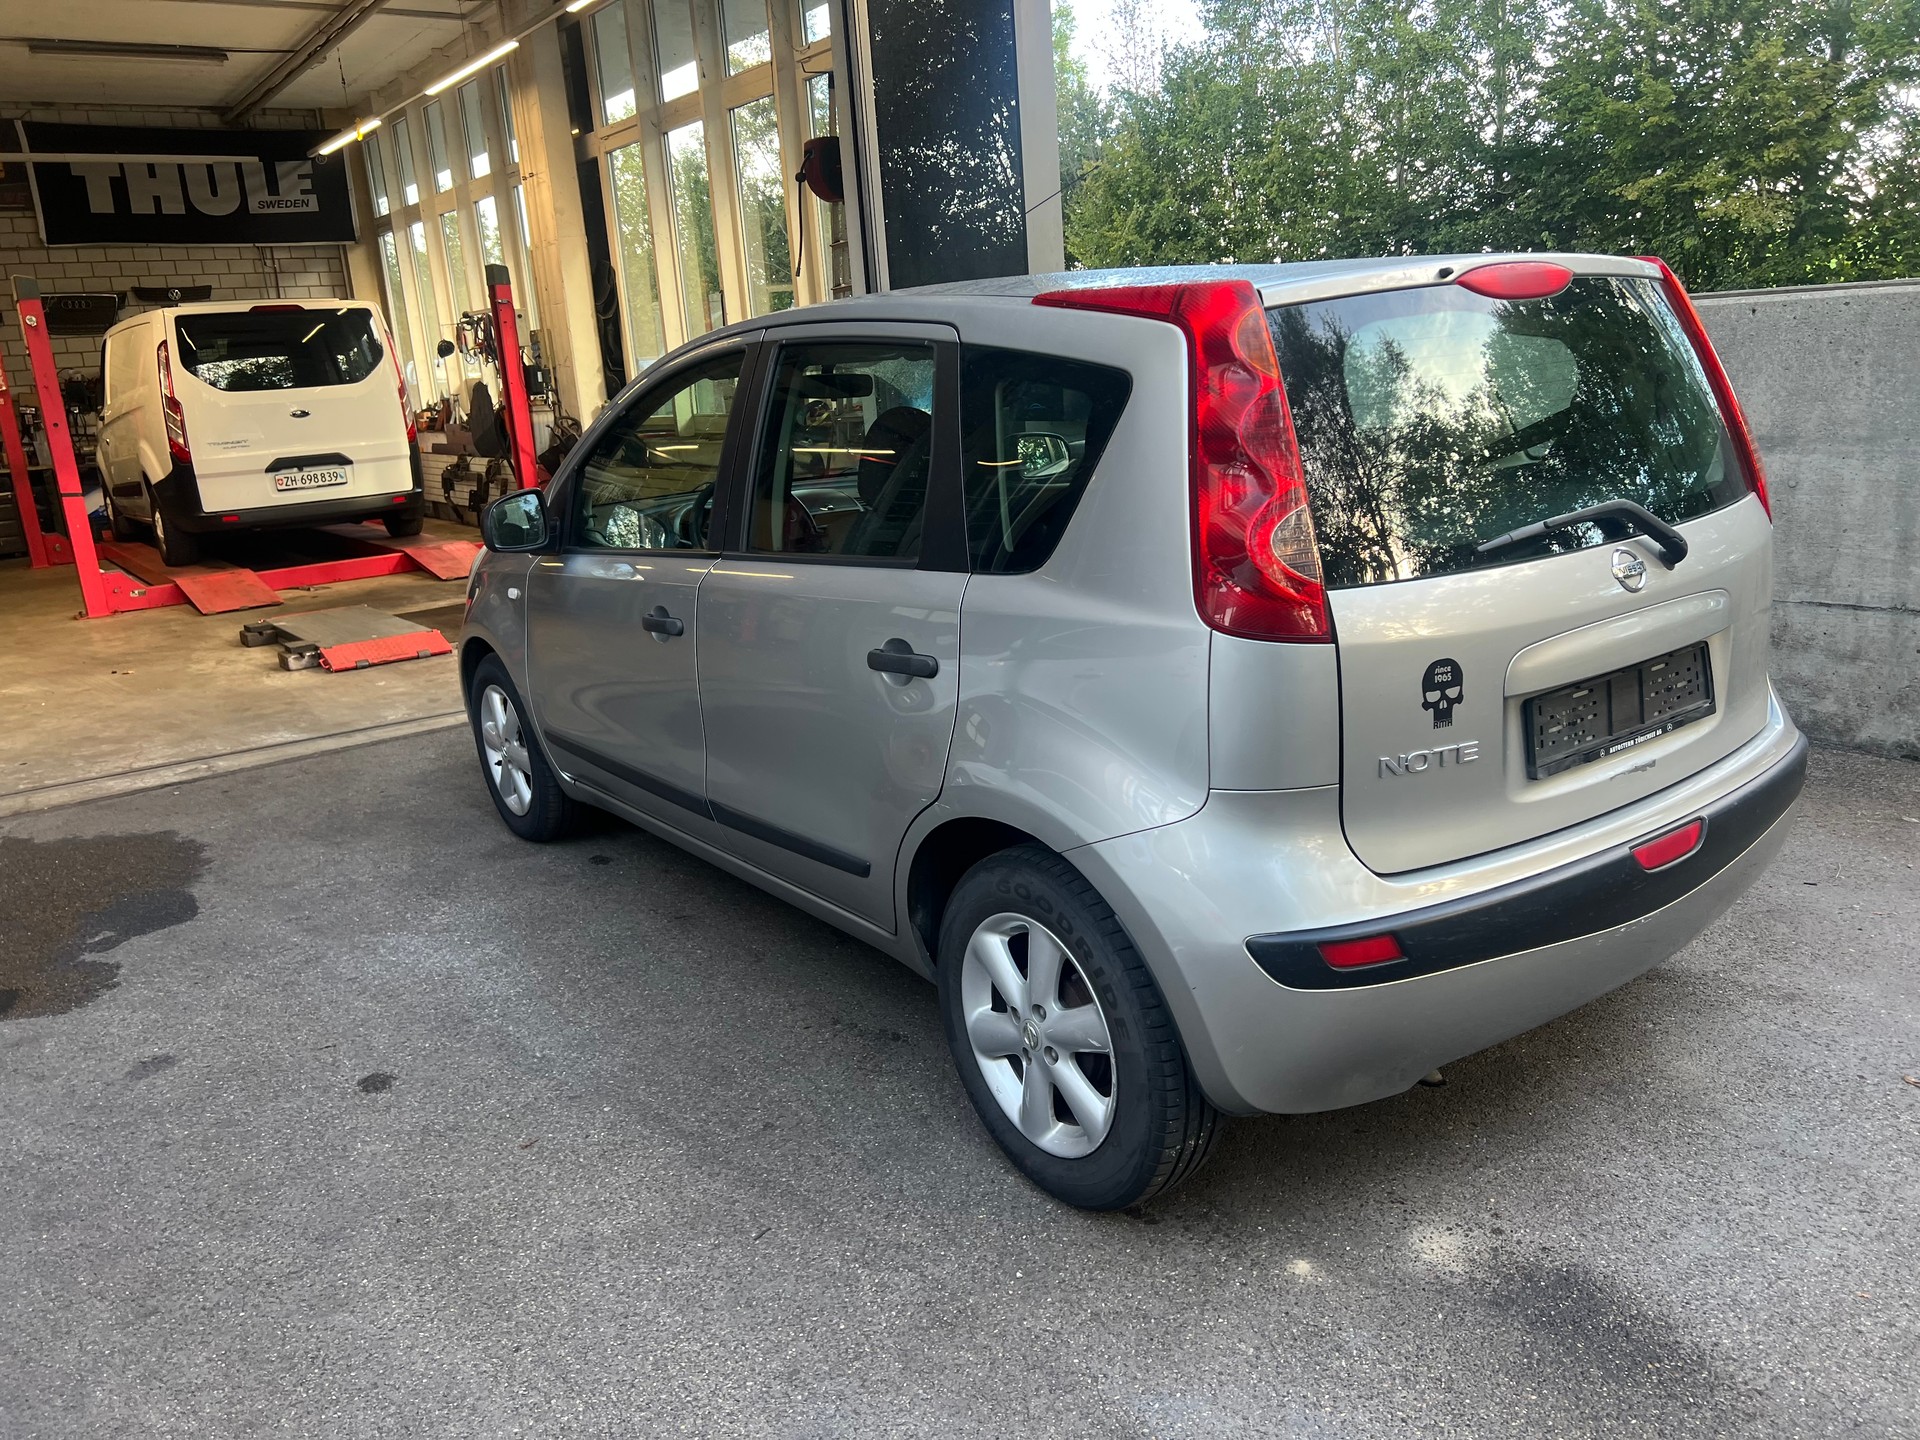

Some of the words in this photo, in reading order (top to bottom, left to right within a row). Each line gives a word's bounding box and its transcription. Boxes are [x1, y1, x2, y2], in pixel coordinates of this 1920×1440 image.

[70, 160, 319, 216] THULE
[257, 198, 310, 210] SWEDEN
[1434, 665, 1452, 674] since
[1434, 673, 1452, 683] 1965
[1378, 740, 1479, 779] NOTE
[994, 877, 1132, 1042] GOODRIDE
